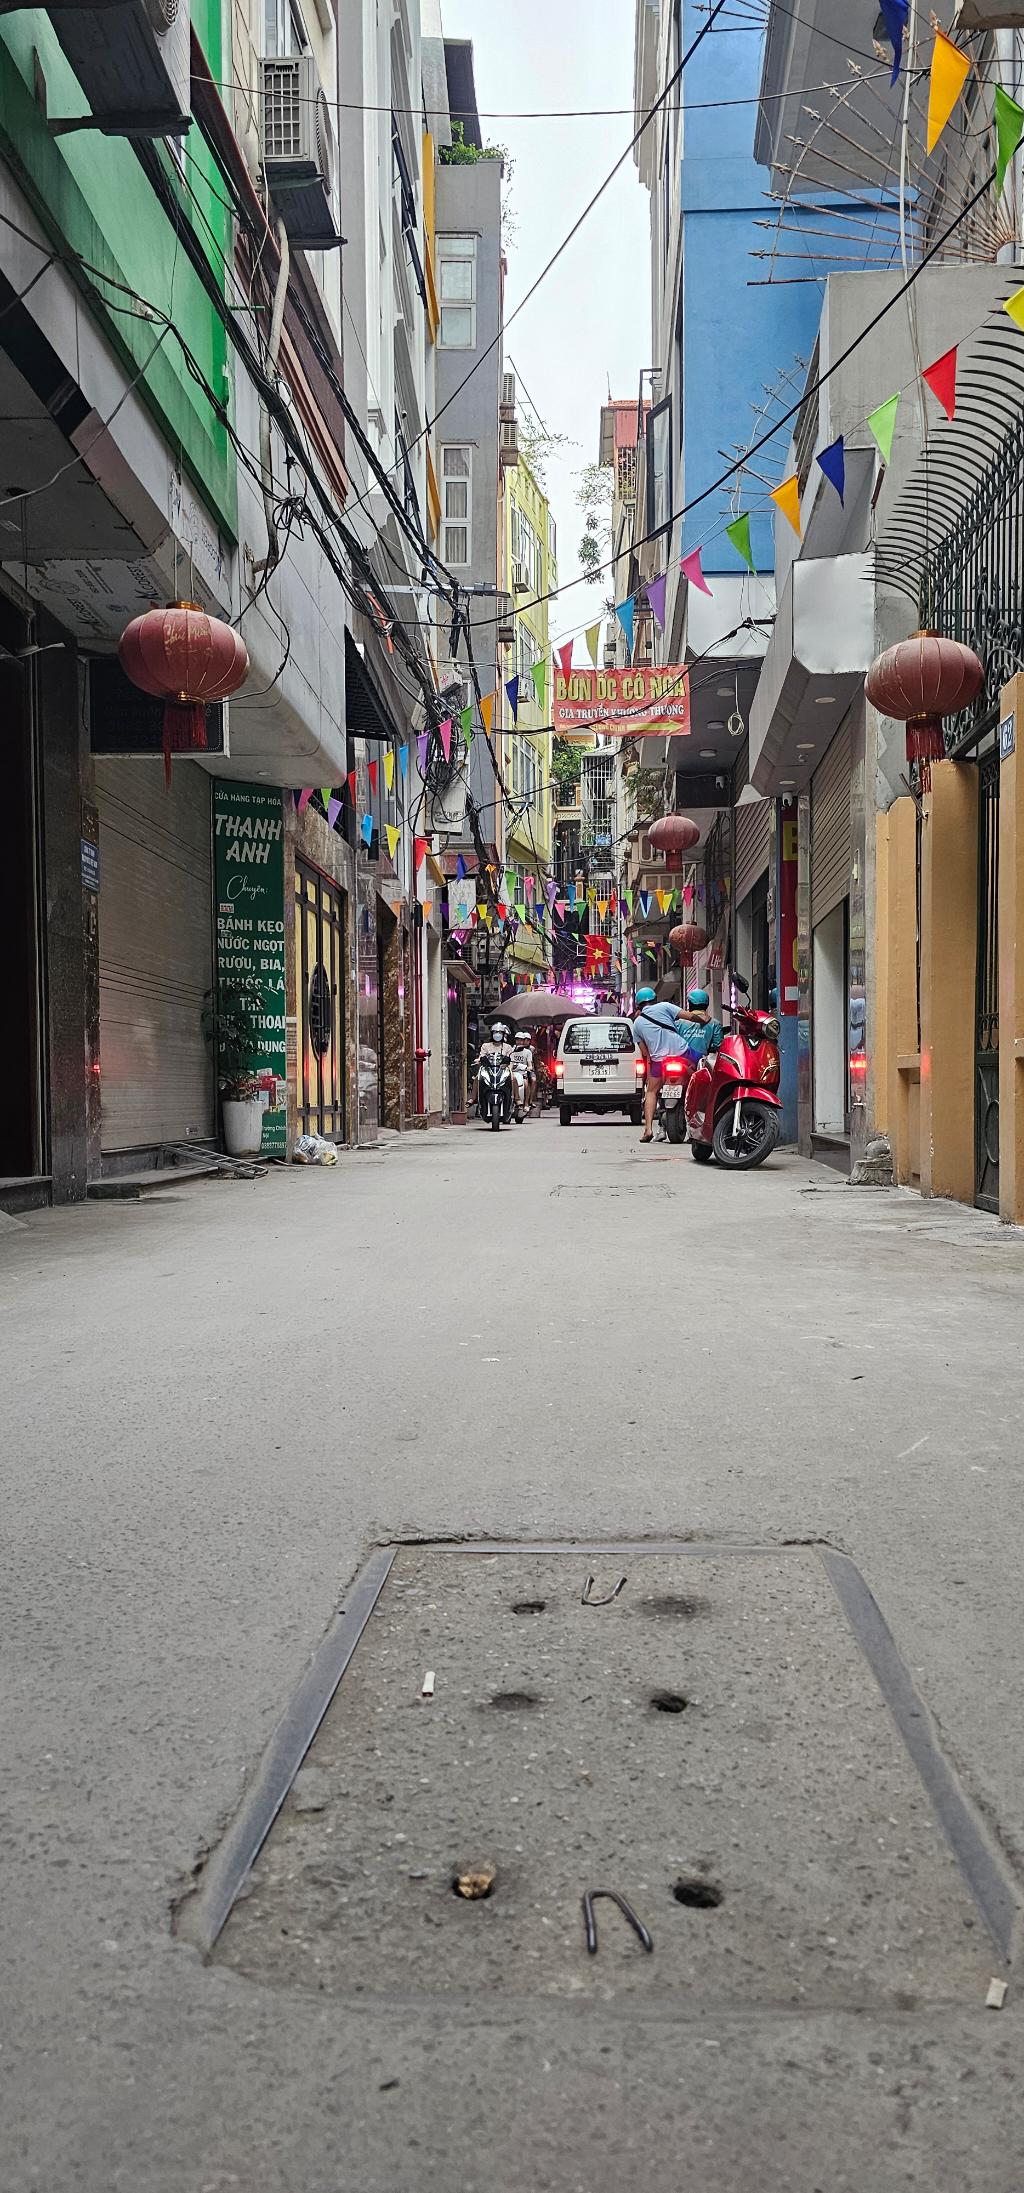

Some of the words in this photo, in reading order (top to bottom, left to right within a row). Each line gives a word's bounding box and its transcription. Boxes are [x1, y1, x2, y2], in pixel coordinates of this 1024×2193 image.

[622, 672, 645, 700] CÔ
[650, 675, 686, 699] NGA
[559, 708, 575, 719] GIA
[214, 789, 229, 801] CỬA
[230, 793, 250, 803] HÀNG
[252, 796, 266, 805] TẠP
[215, 813, 283, 841] THANH
[225, 840, 271, 864] ANH
[217, 915, 253, 931] BÁNH
[257, 920, 284, 935] KẸO
[217, 935, 250, 950] NƯỚC
[253, 939, 284, 954] NGỌT
[218, 955, 256, 971] RƯỢU,
[260, 958, 285, 973] BIA,
